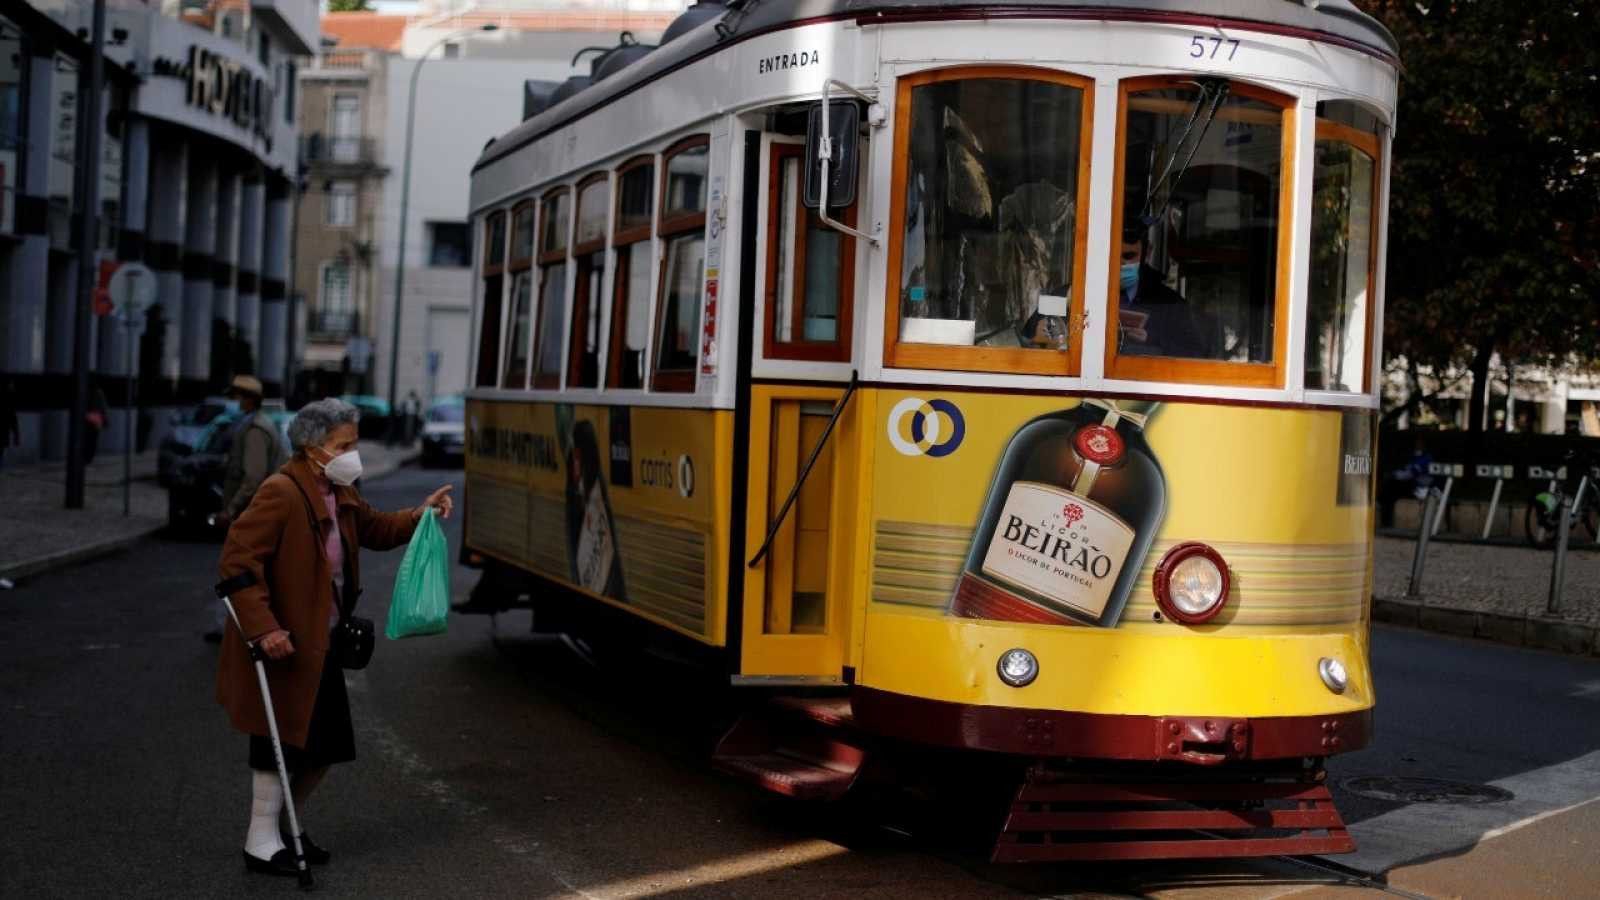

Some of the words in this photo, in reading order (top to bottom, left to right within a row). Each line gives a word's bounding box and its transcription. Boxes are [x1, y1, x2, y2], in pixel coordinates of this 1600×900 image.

[1190, 35, 1241, 61] 577
[759, 50, 819, 74] ENTRADA
[1003, 514, 1112, 580] BEIRÃO
[1053, 567, 1094, 588] PORTUGAL
